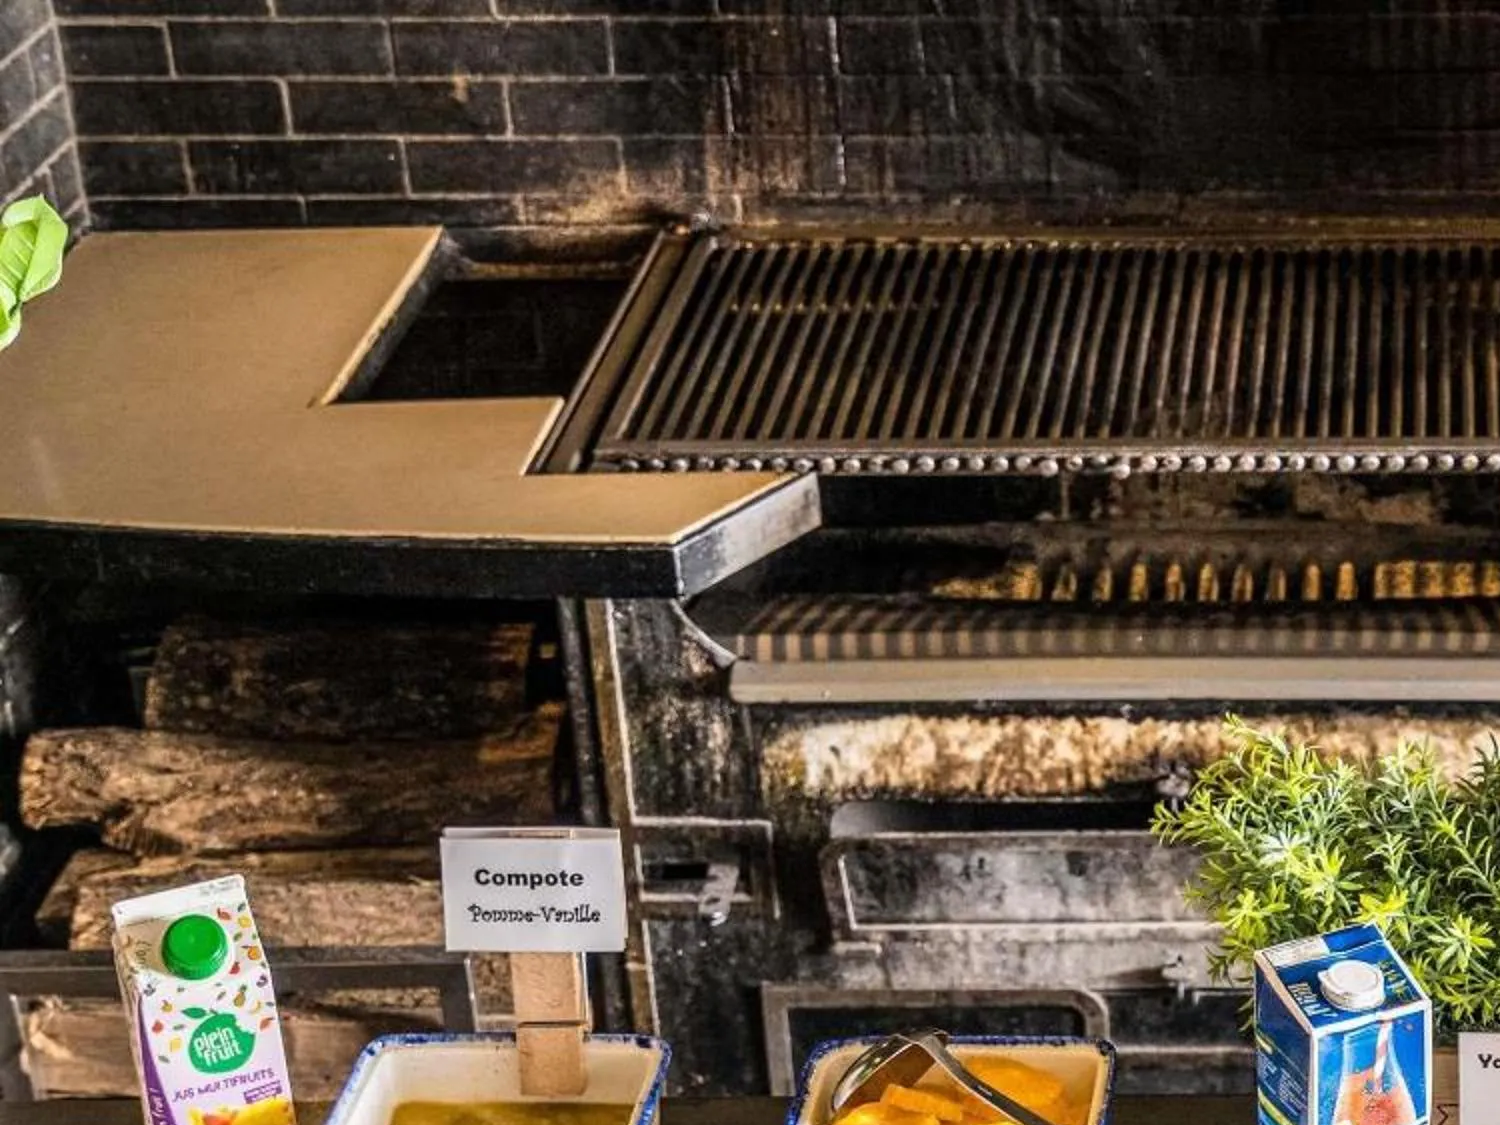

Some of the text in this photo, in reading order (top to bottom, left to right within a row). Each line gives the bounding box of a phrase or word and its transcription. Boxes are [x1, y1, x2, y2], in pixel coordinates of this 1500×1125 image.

[474, 869, 584, 890] Compote
[467, 904, 600, 922] Pomme-Vanille
[193, 1027, 234, 1057] plein
[201, 1041, 241, 1067] fruit
[173, 1087, 195, 1102] JUS
